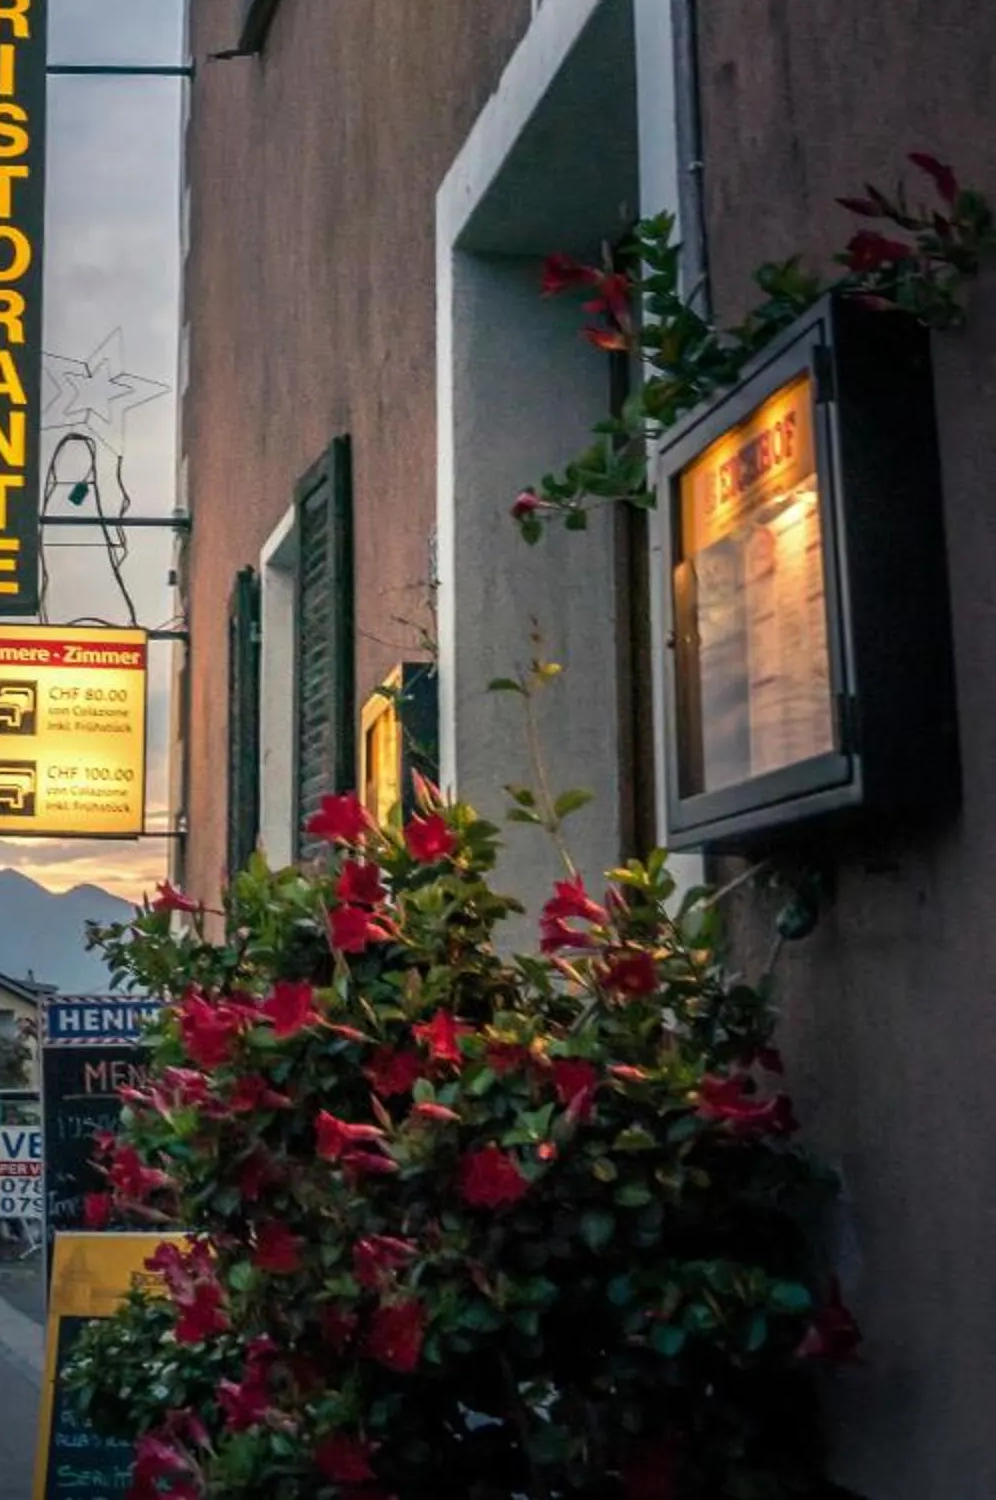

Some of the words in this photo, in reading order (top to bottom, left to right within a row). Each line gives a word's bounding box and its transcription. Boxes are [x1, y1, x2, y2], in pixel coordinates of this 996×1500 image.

[63, 645, 141, 665] Zimmer
[48, 686, 80, 701] CHF
[47, 765, 79, 780] CHF
[84, 766, 135, 782] 100.00
